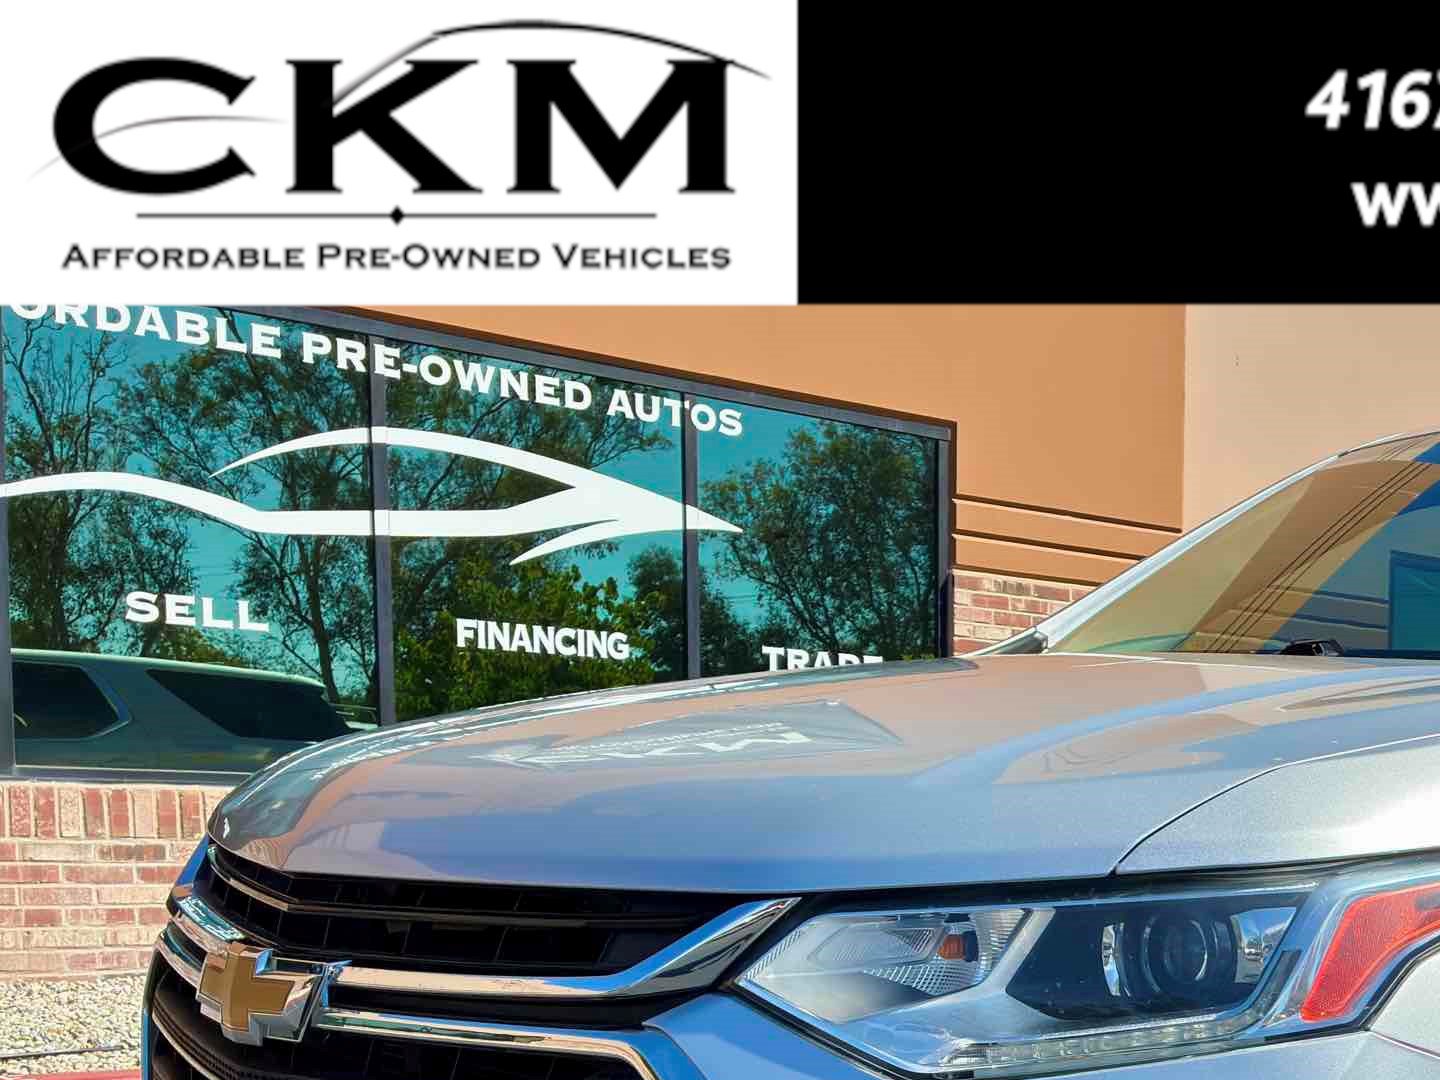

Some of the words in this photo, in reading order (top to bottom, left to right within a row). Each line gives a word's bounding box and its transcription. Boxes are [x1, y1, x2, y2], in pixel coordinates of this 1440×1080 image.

[302, 332, 592, 410] PRE-OWNED
[606, 389, 743, 436] AUTOS
[125, 591, 270, 632] SELL
[456, 619, 630, 661] FINANCING
[762, 646, 883, 672] TRA
